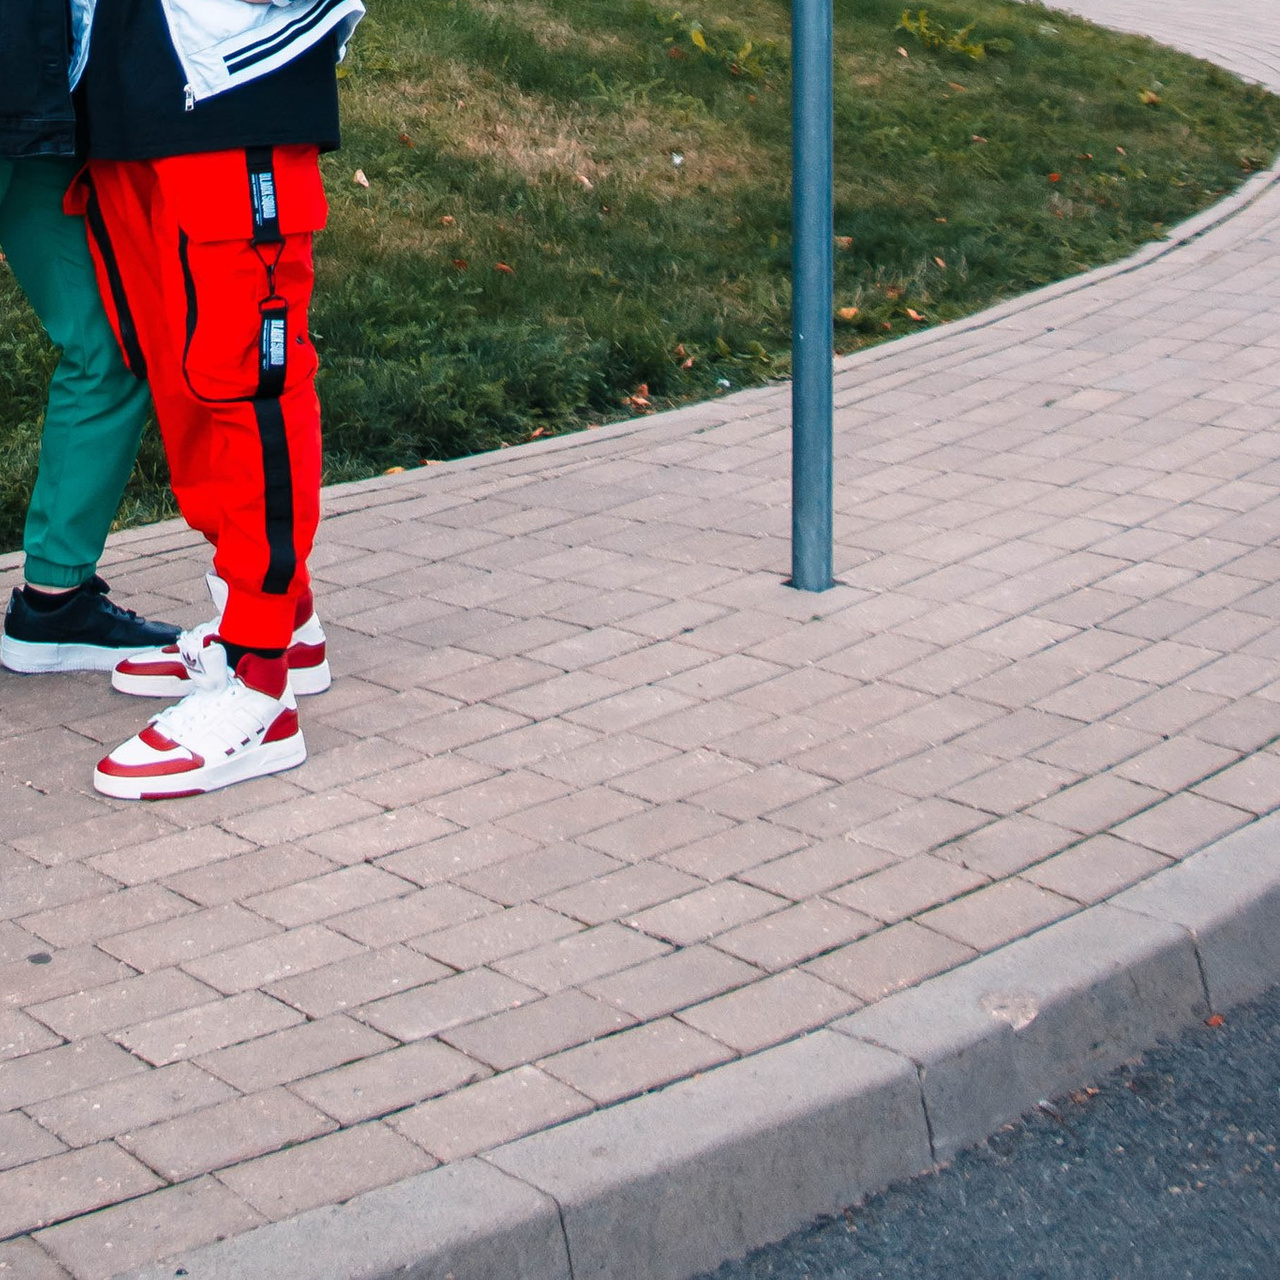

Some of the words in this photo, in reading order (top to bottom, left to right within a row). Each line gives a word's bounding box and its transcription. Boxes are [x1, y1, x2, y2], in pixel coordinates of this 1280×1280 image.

[258, 171, 274, 195] BLACK
[261, 194, 276, 218] SQUAD
[270, 319, 284, 342] BLACK
[270, 342, 284, 365] SQUAD
